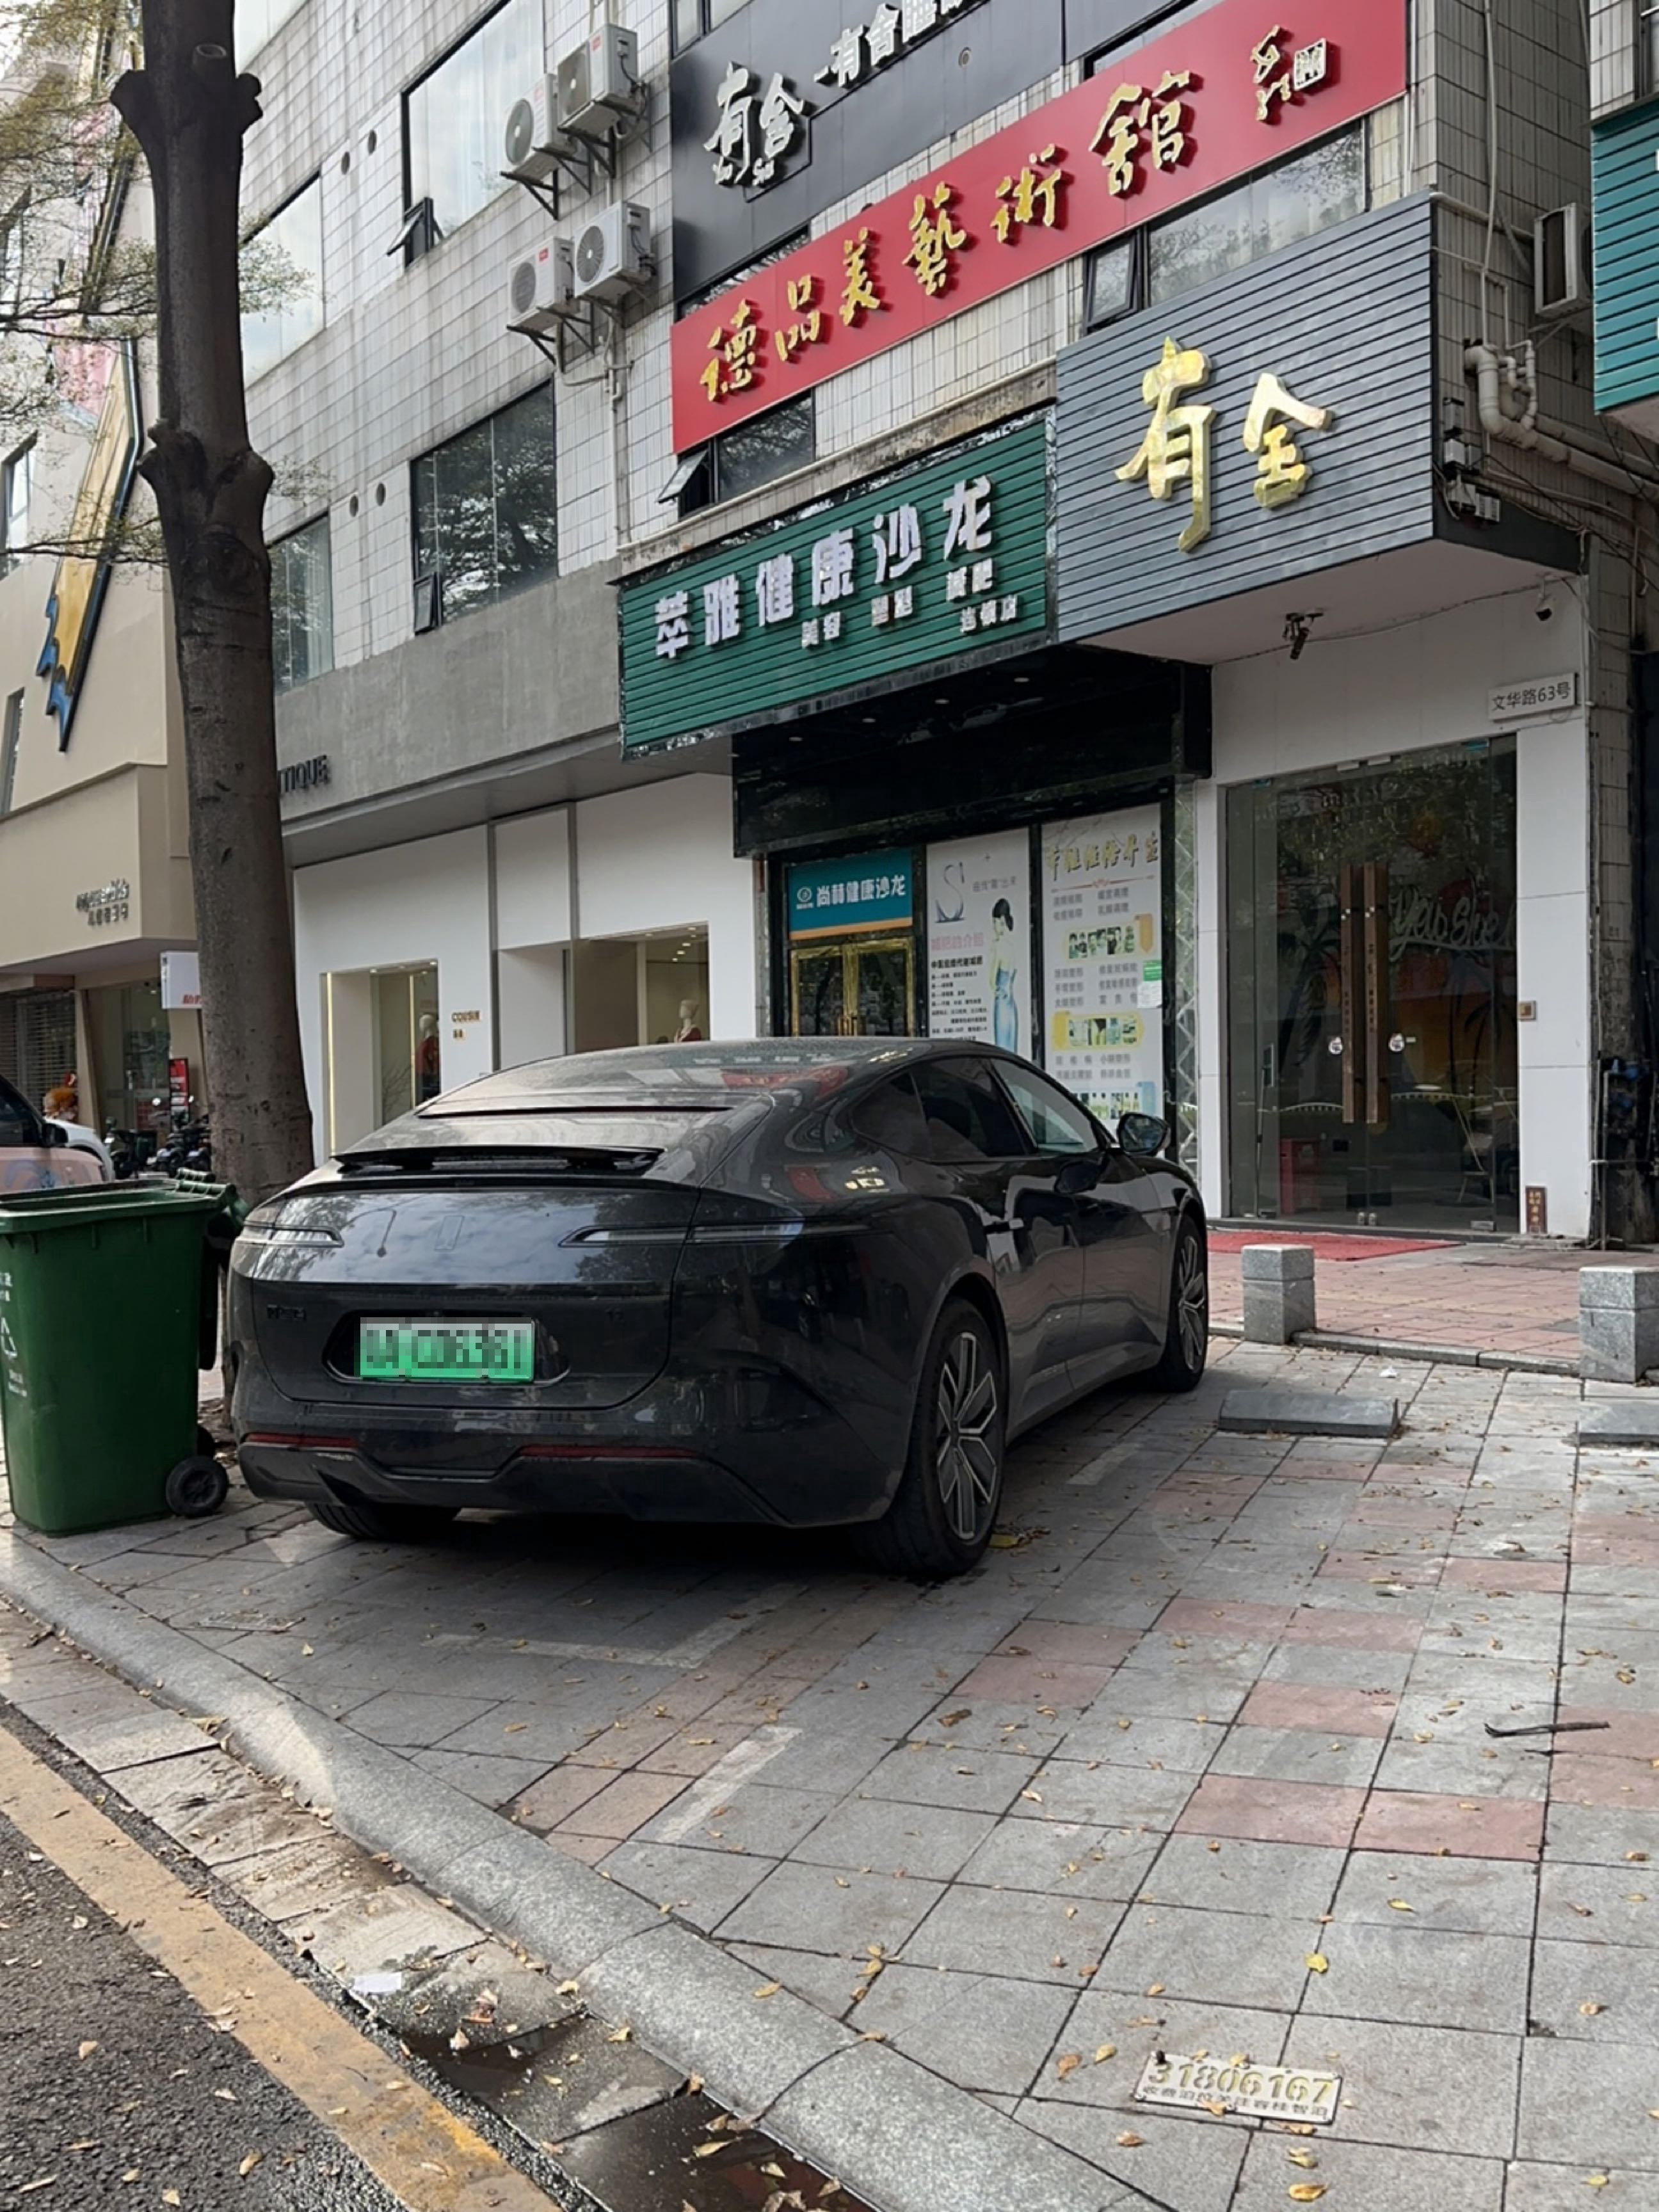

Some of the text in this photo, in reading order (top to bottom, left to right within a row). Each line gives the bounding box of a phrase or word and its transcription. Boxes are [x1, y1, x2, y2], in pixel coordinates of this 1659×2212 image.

[655, 476, 992, 659] 萃雅健康沙龙
[1492, 681, 1571, 712] 文华路63号
[1148, 2062, 1333, 2103] 31806167
